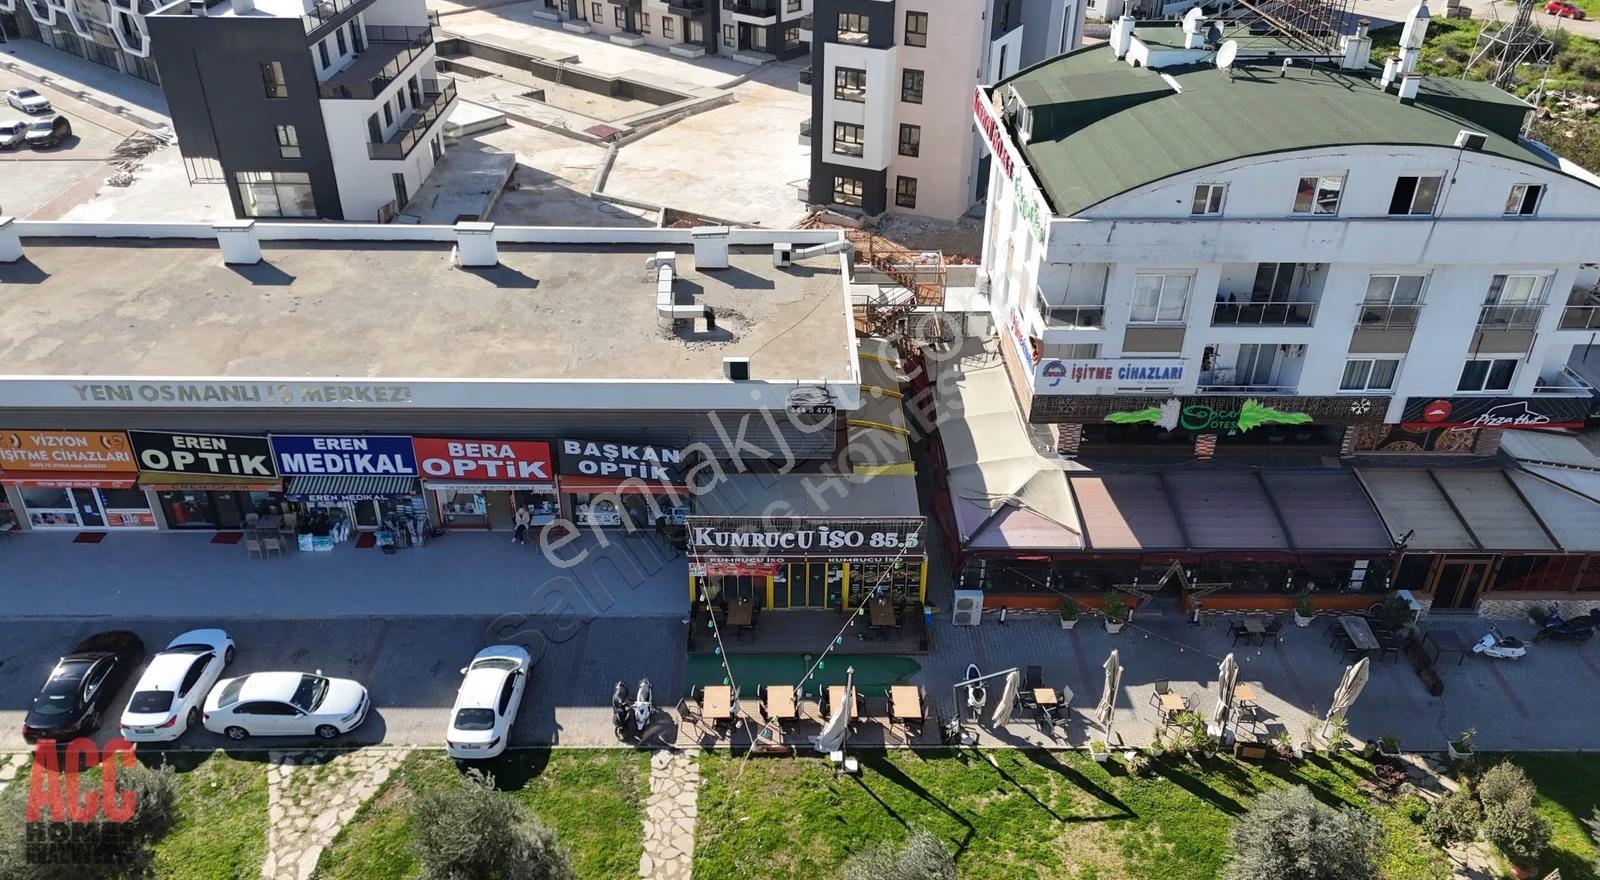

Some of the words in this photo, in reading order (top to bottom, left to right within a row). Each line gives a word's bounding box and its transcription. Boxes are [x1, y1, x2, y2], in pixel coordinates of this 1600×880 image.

[1071, 362, 1113, 383] İŞİTME
[31, 434, 88, 447] VİZYON
[172, 436, 227, 450] EREN
[313, 438, 367, 451] EREN
[447, 442, 517, 459] BERA
[563, 440, 680, 463] BAŞKAN
[141, 449, 271, 476] OPTİK
[281, 453, 412, 474] MEDİKAL
[422, 457, 549, 479] OPTİK
[578, 461, 671, 482] OPTİK
[694, 526, 815, 549] KUMRUCU
[818, 526, 864, 548] İSO
